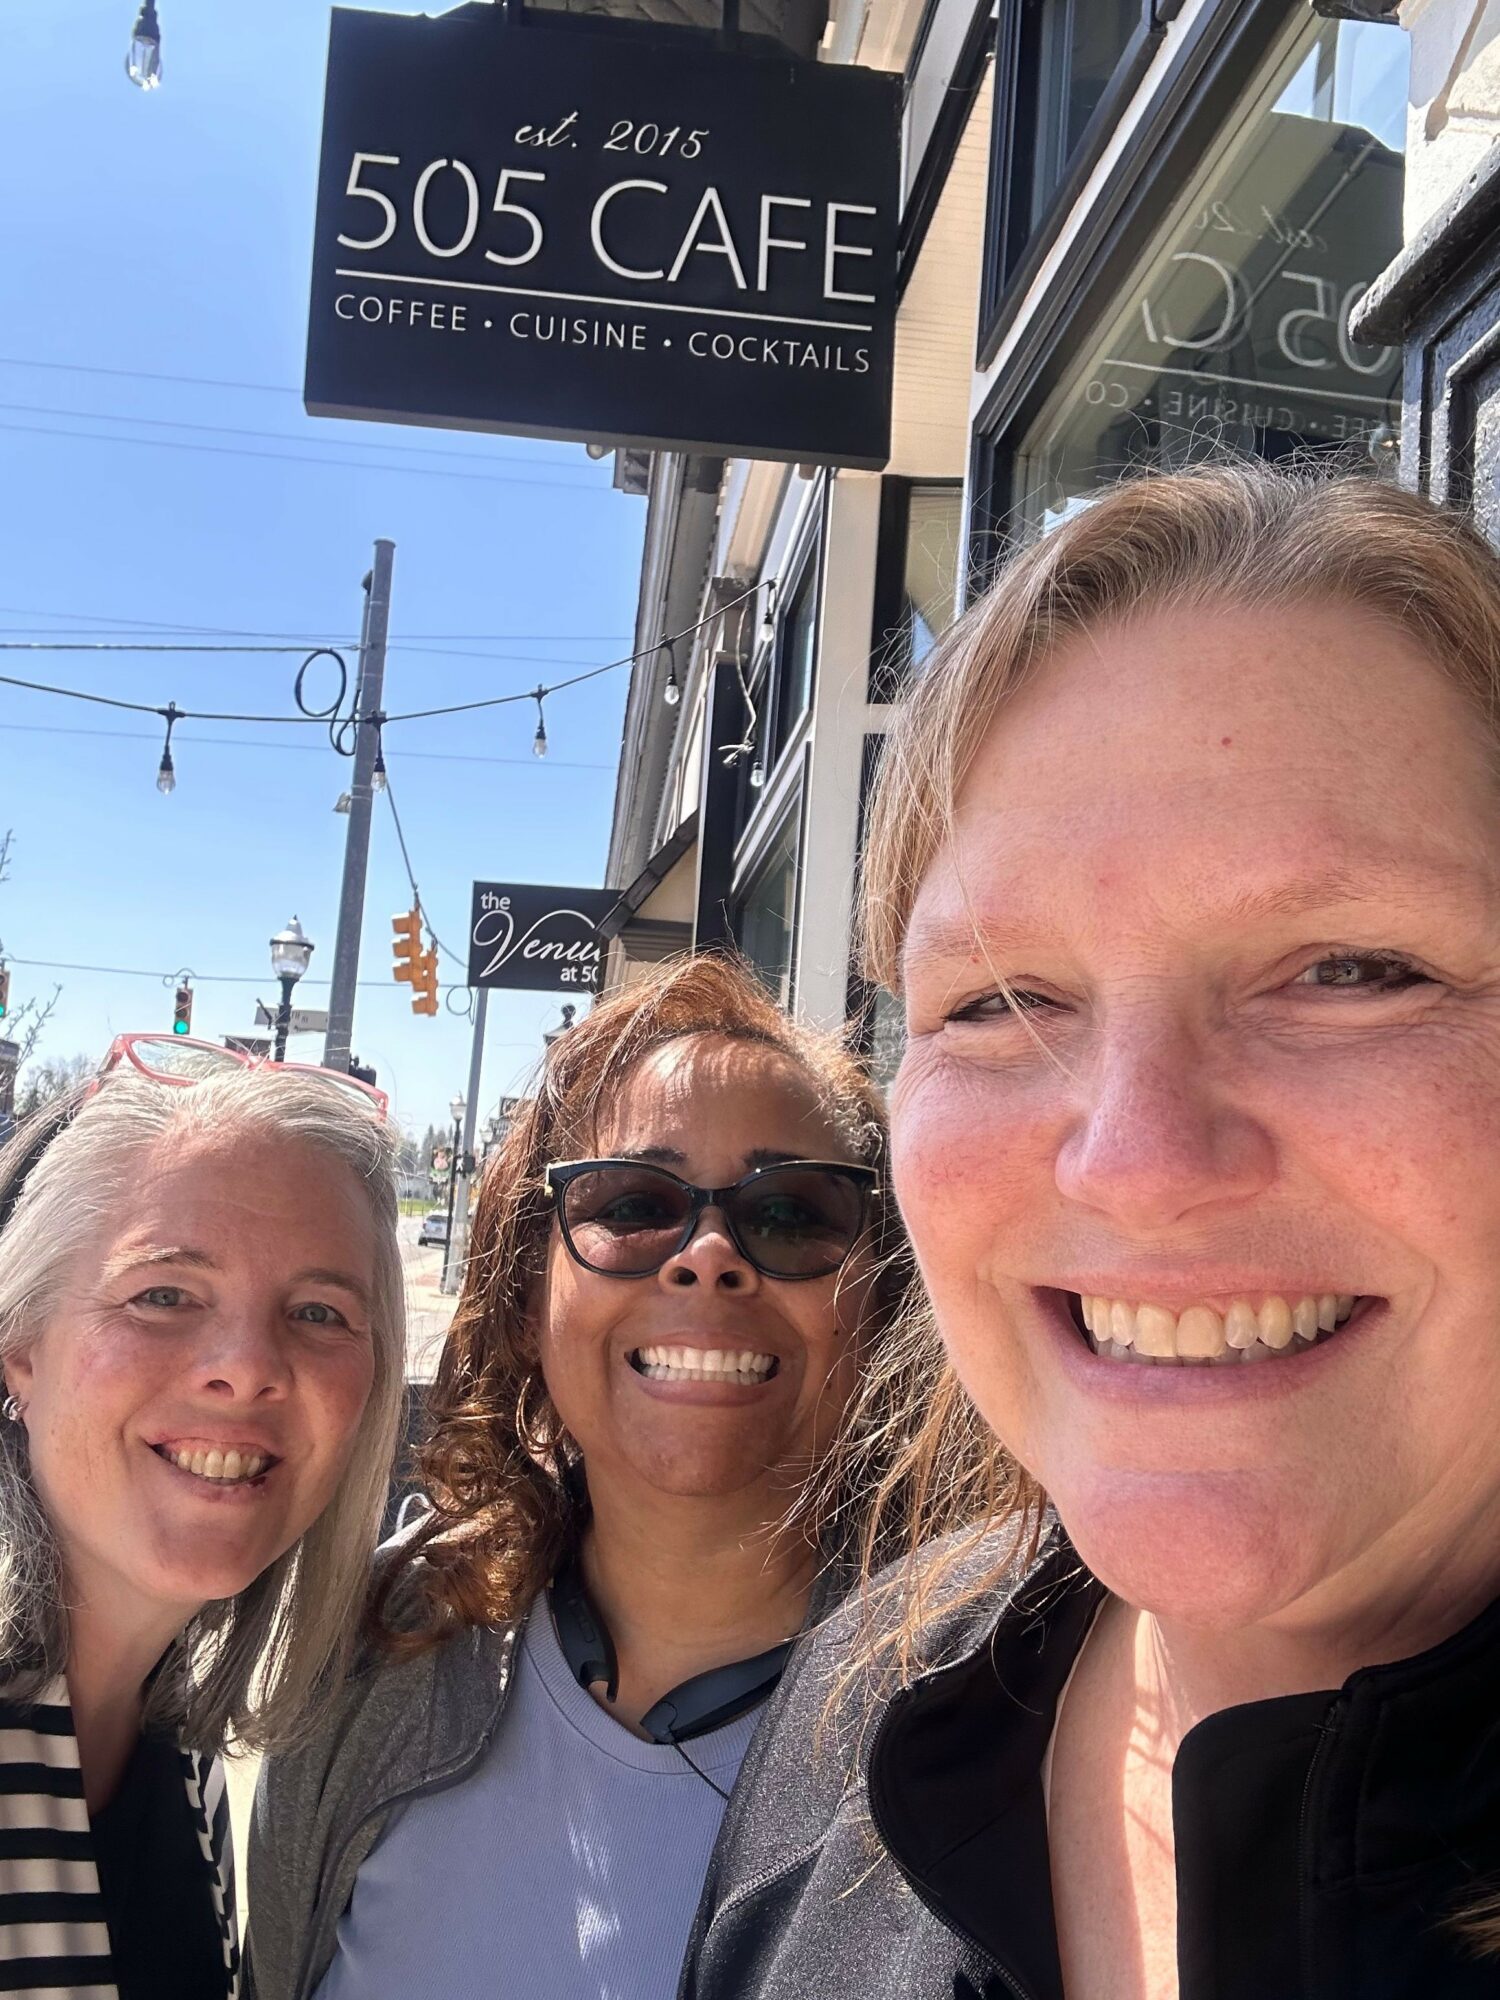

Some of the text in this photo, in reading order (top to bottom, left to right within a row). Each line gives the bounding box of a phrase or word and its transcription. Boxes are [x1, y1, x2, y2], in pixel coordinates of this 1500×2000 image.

[515, 112, 710, 159] est. 2015
[336, 152, 877, 303] 505 CAFE
[334, 294, 870, 373] COFFEE CUISINE COCKTAILS
[480, 891, 511, 910] the
[560, 966, 578, 982] at
